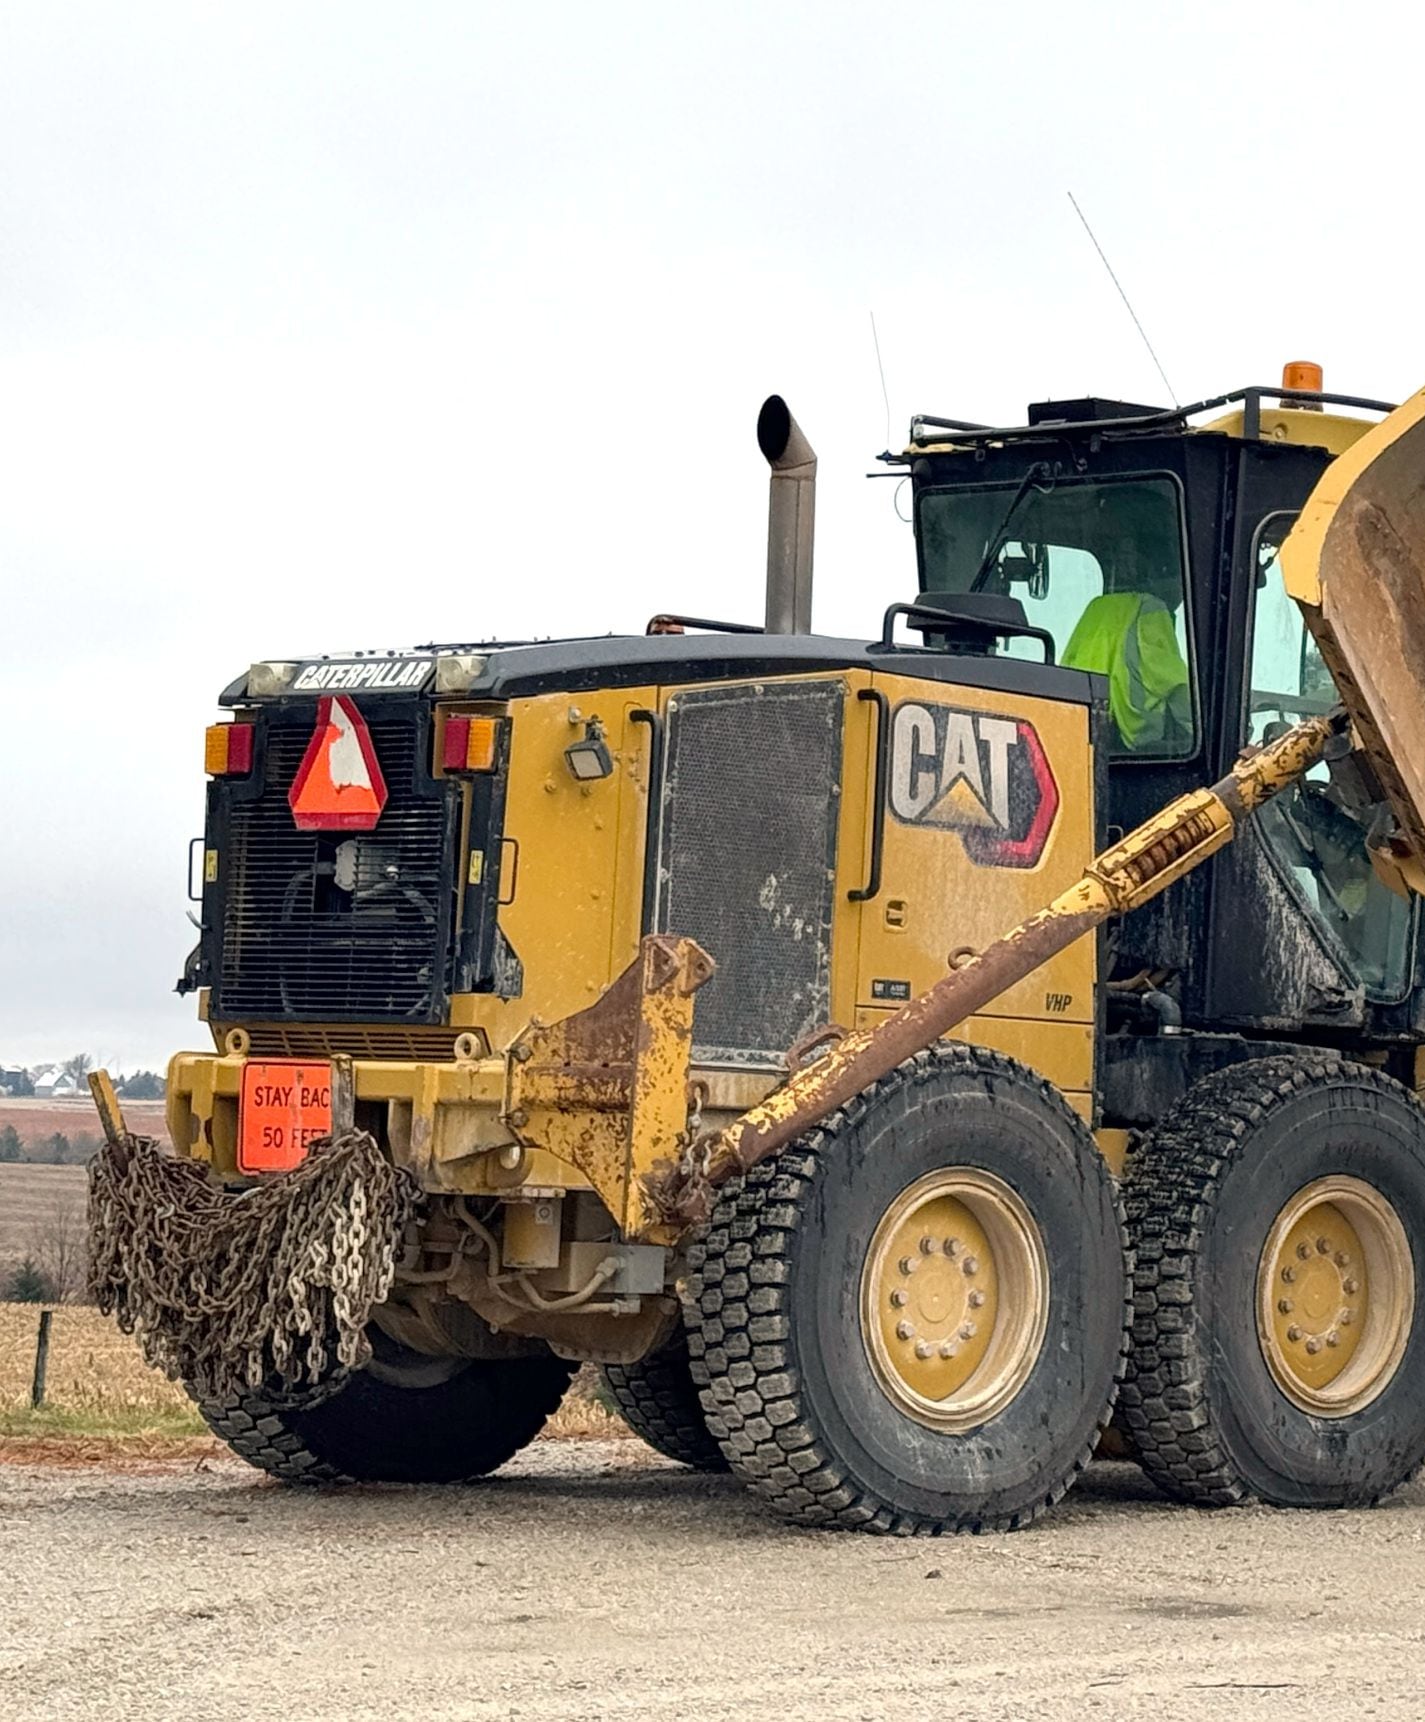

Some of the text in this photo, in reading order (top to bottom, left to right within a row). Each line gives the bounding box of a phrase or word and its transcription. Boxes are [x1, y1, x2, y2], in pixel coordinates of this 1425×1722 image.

[294, 661, 432, 690] CATERPILLAR
[892, 703, 1018, 830] CAT
[1046, 992, 1073, 1012] VHP
[254, 1086, 330, 1108] STAY BAC
[263, 1127, 284, 1148] 50
